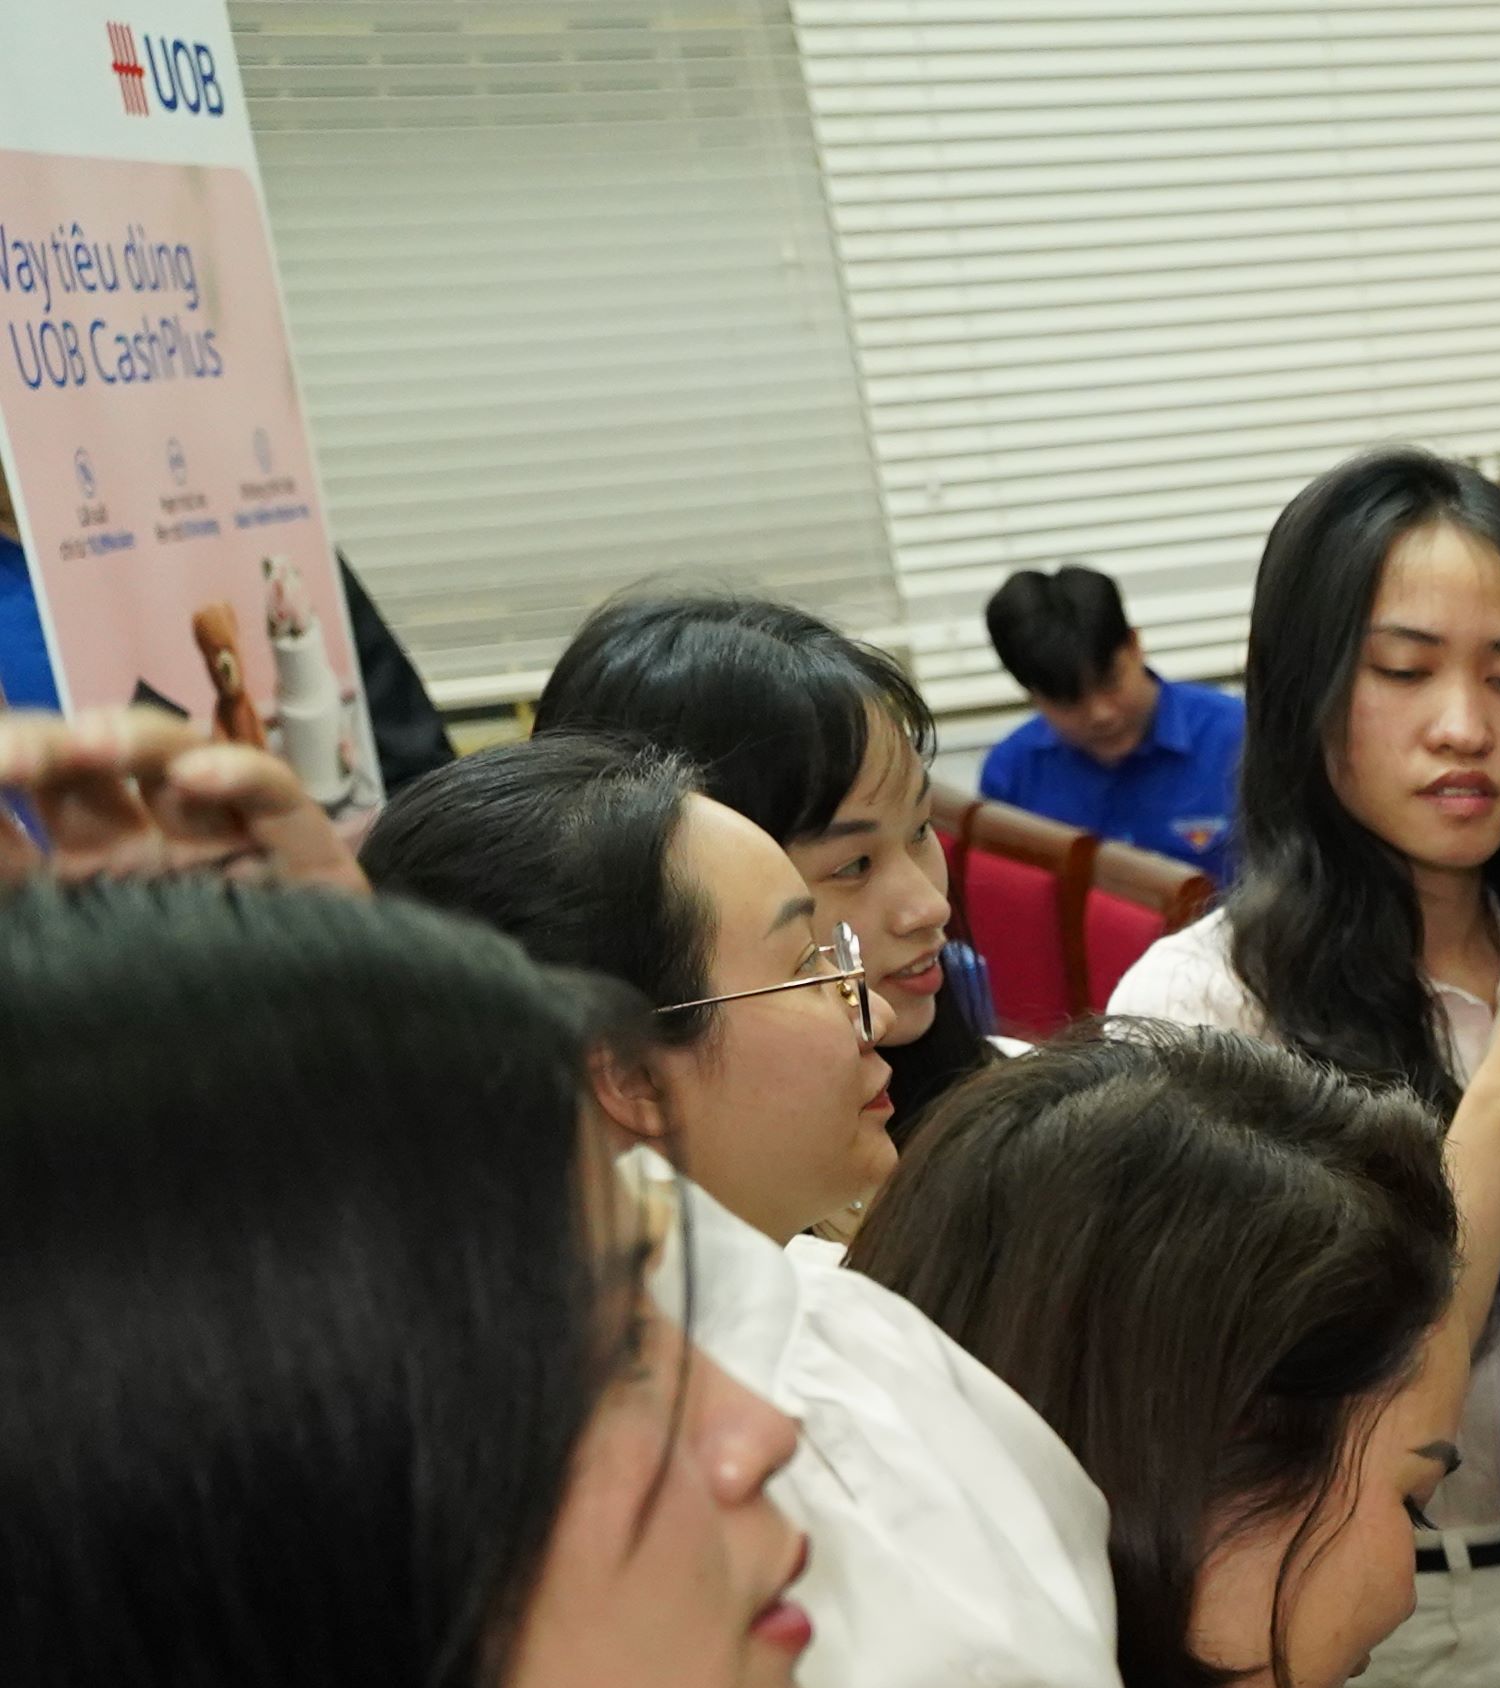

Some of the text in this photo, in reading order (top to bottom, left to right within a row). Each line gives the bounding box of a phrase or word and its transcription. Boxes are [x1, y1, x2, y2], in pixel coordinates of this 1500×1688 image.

[144, 34, 225, 118] UOB
[51, 222, 119, 292] tiêu
[9, 315, 223, 390] UOB CashPlus
